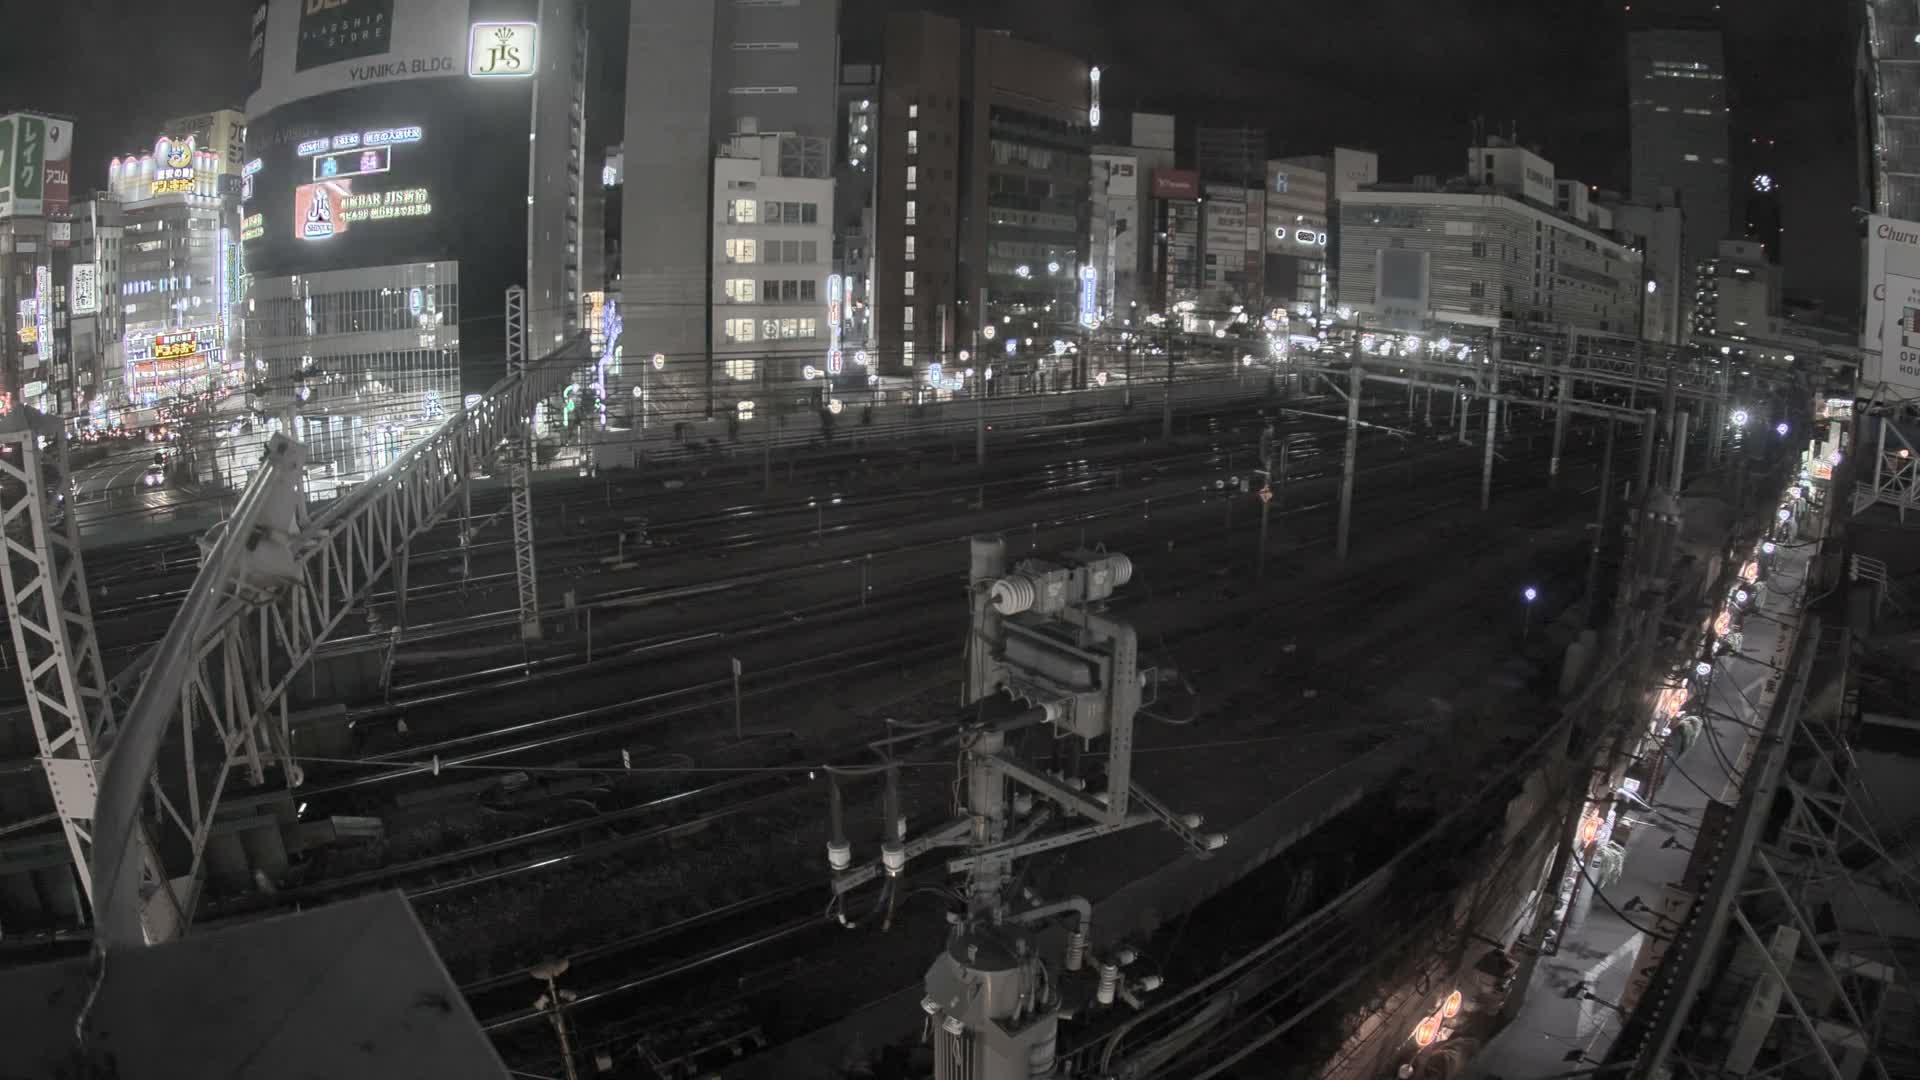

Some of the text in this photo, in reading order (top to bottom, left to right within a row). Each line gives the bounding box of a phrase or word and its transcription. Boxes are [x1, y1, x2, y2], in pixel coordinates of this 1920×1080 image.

[303, 13, 384, 41] AGSHIP
[327, 27, 384, 47] STORE
[350, 60, 408, 81] YUNIKA
[21, 120, 37, 187] レイク
[46, 168, 68, 184] アコム
[1877, 224, 1919, 245] Churu
[1900, 351, 1920, 366] OP
